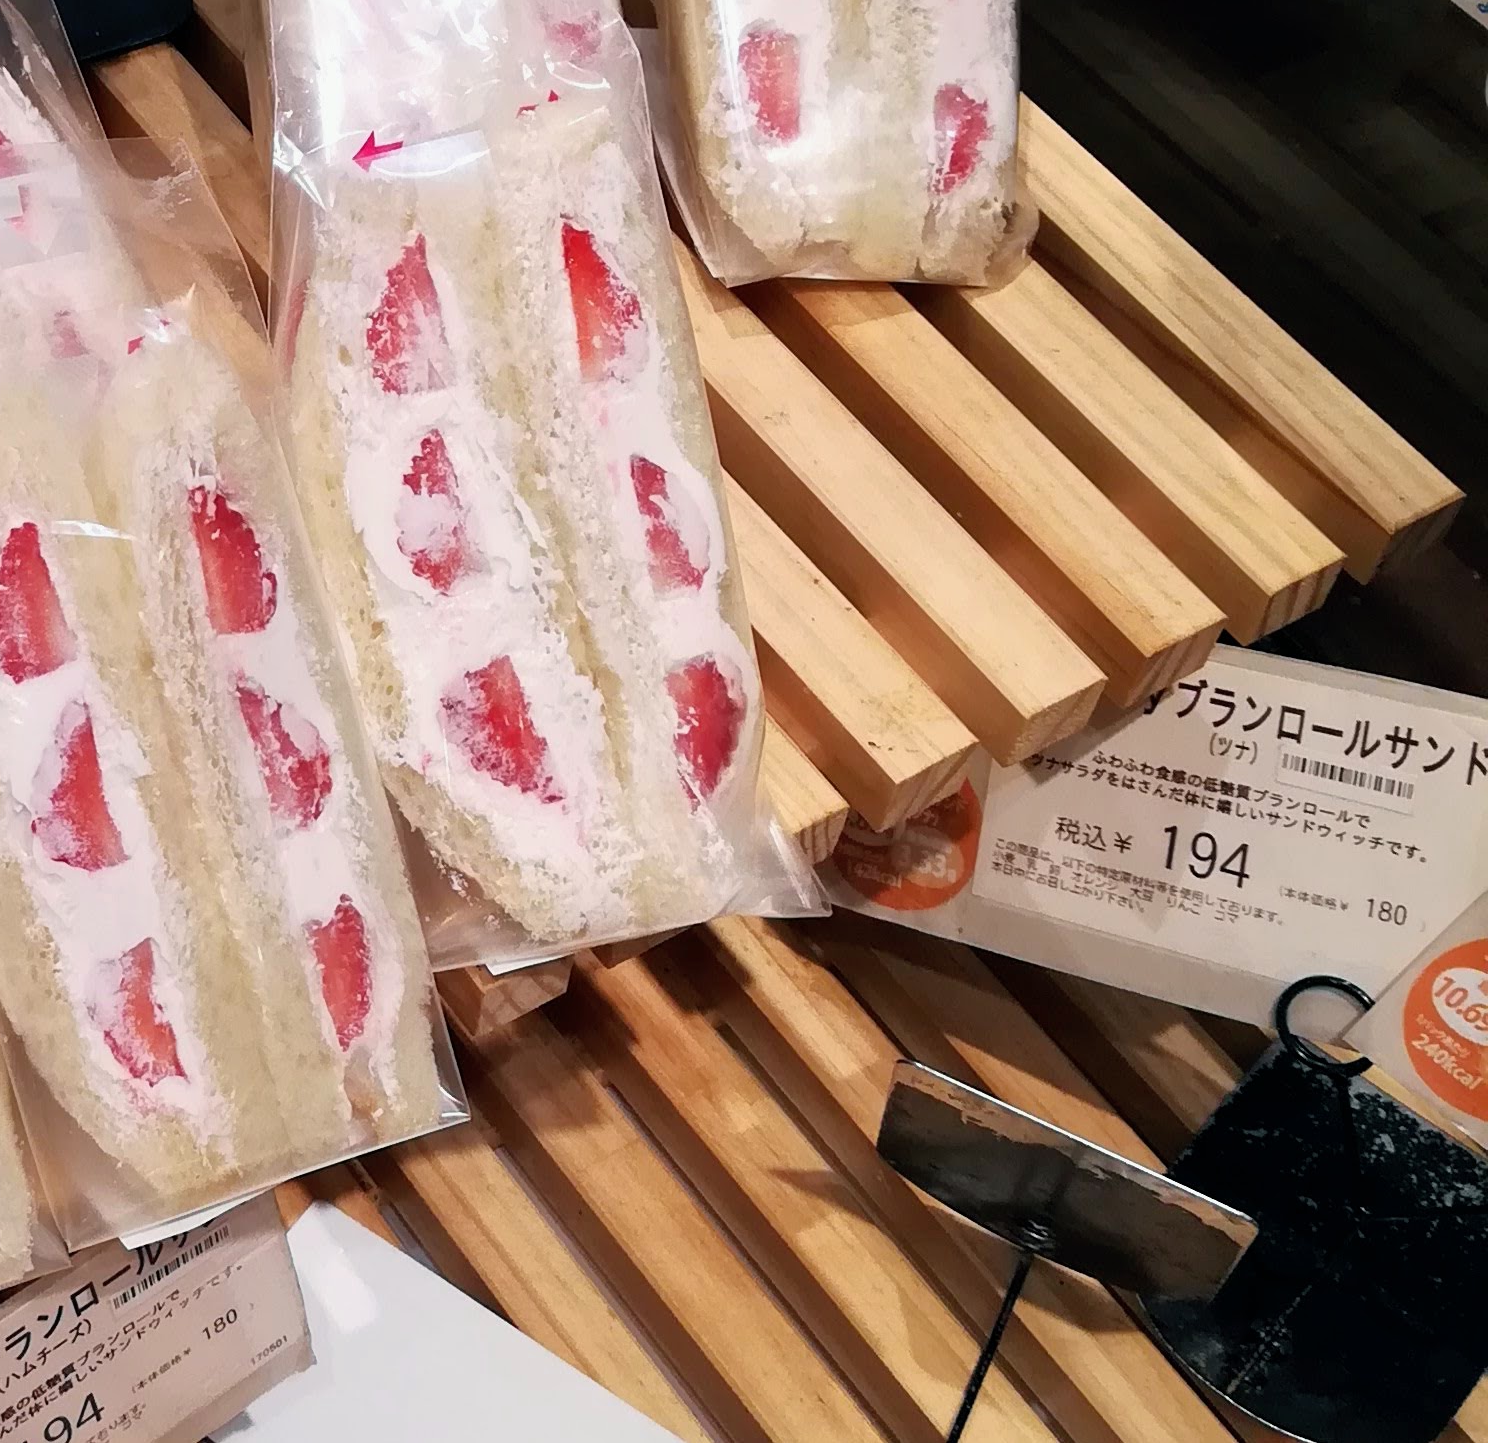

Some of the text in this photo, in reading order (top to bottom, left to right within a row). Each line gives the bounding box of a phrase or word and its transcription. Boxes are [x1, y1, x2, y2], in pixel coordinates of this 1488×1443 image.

[1091, 749, 1371, 830] ふわふわ食感の低糖質ブランロールで
[1163, 824, 1250, 889] 194
[1366, 898, 1408, 926] 180
[1412, 1033, 1484, 1091] 240kcal
[202, 1308, 239, 1341] 180
